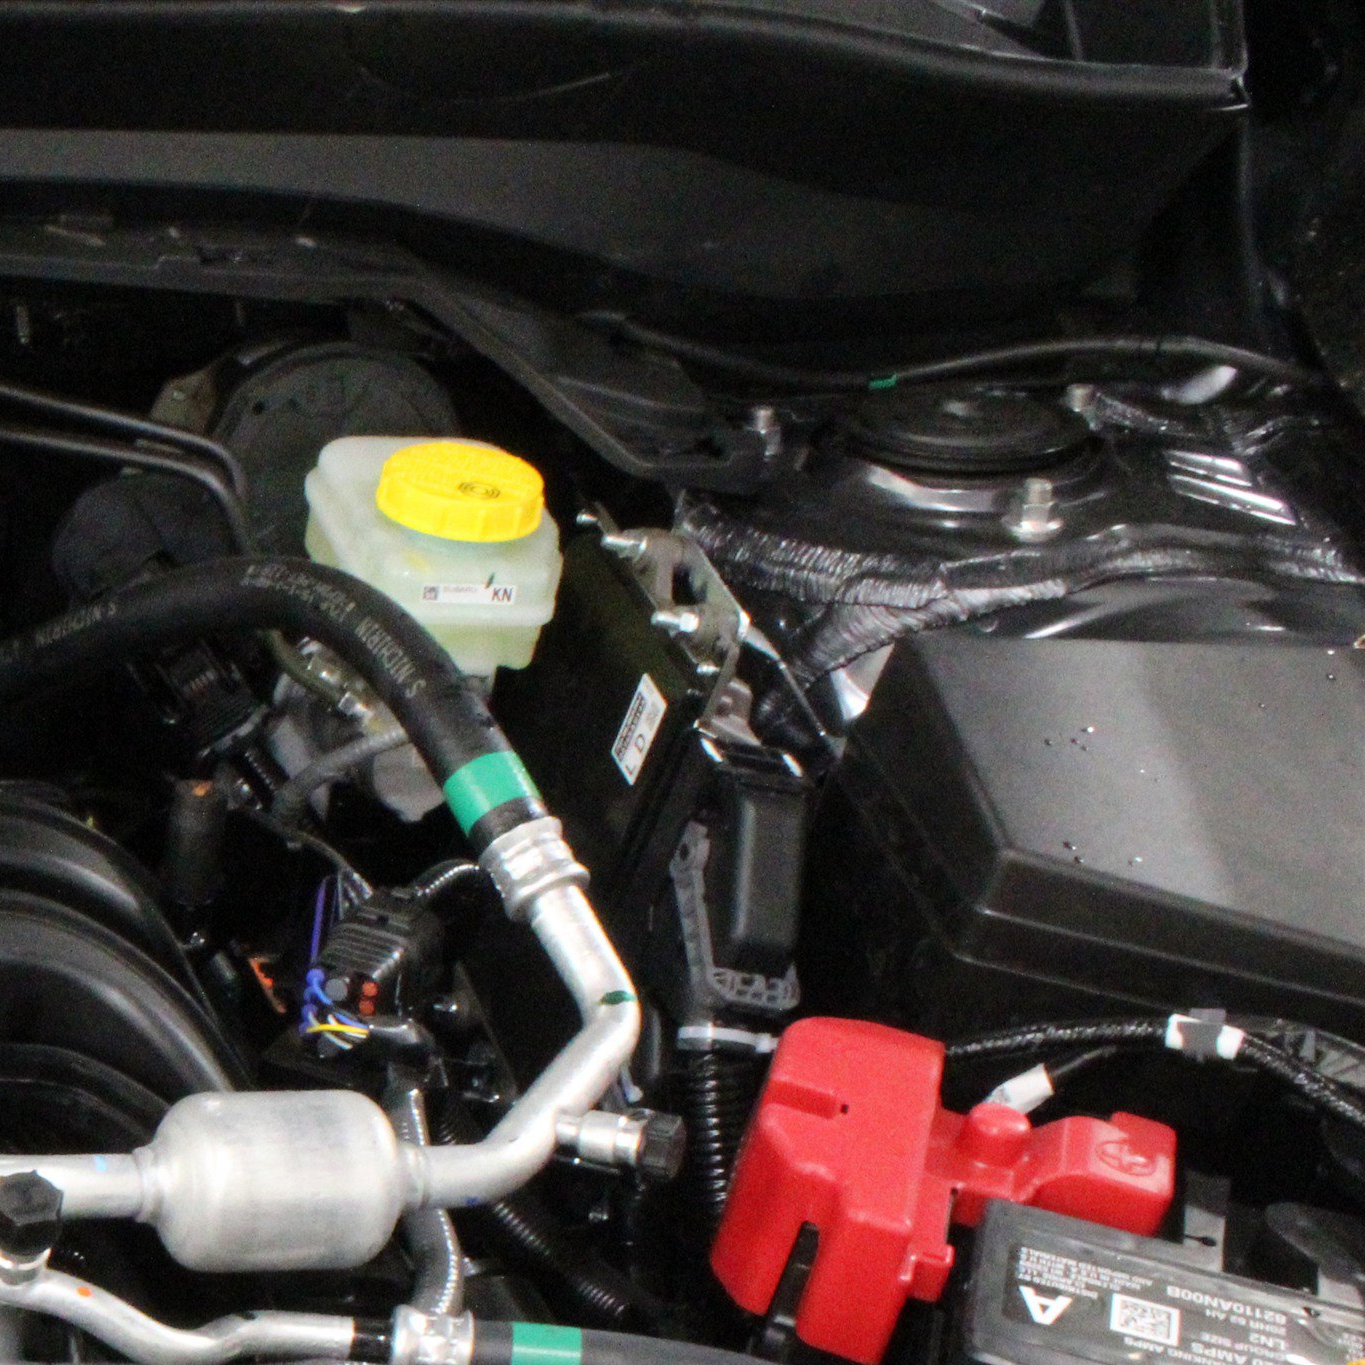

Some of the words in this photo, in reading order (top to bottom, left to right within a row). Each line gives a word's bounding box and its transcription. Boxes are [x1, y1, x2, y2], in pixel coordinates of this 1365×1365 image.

[490, 587, 512, 601] KN
[1124, 1336, 1165, 1352] AMPS
[1200, 1332, 1233, 1347] SIZE
[1249, 1332, 1286, 1350] LN2
[1190, 1342, 1247, 1365] AMPS
[1234, 1342, 1286, 1361] GROUP
